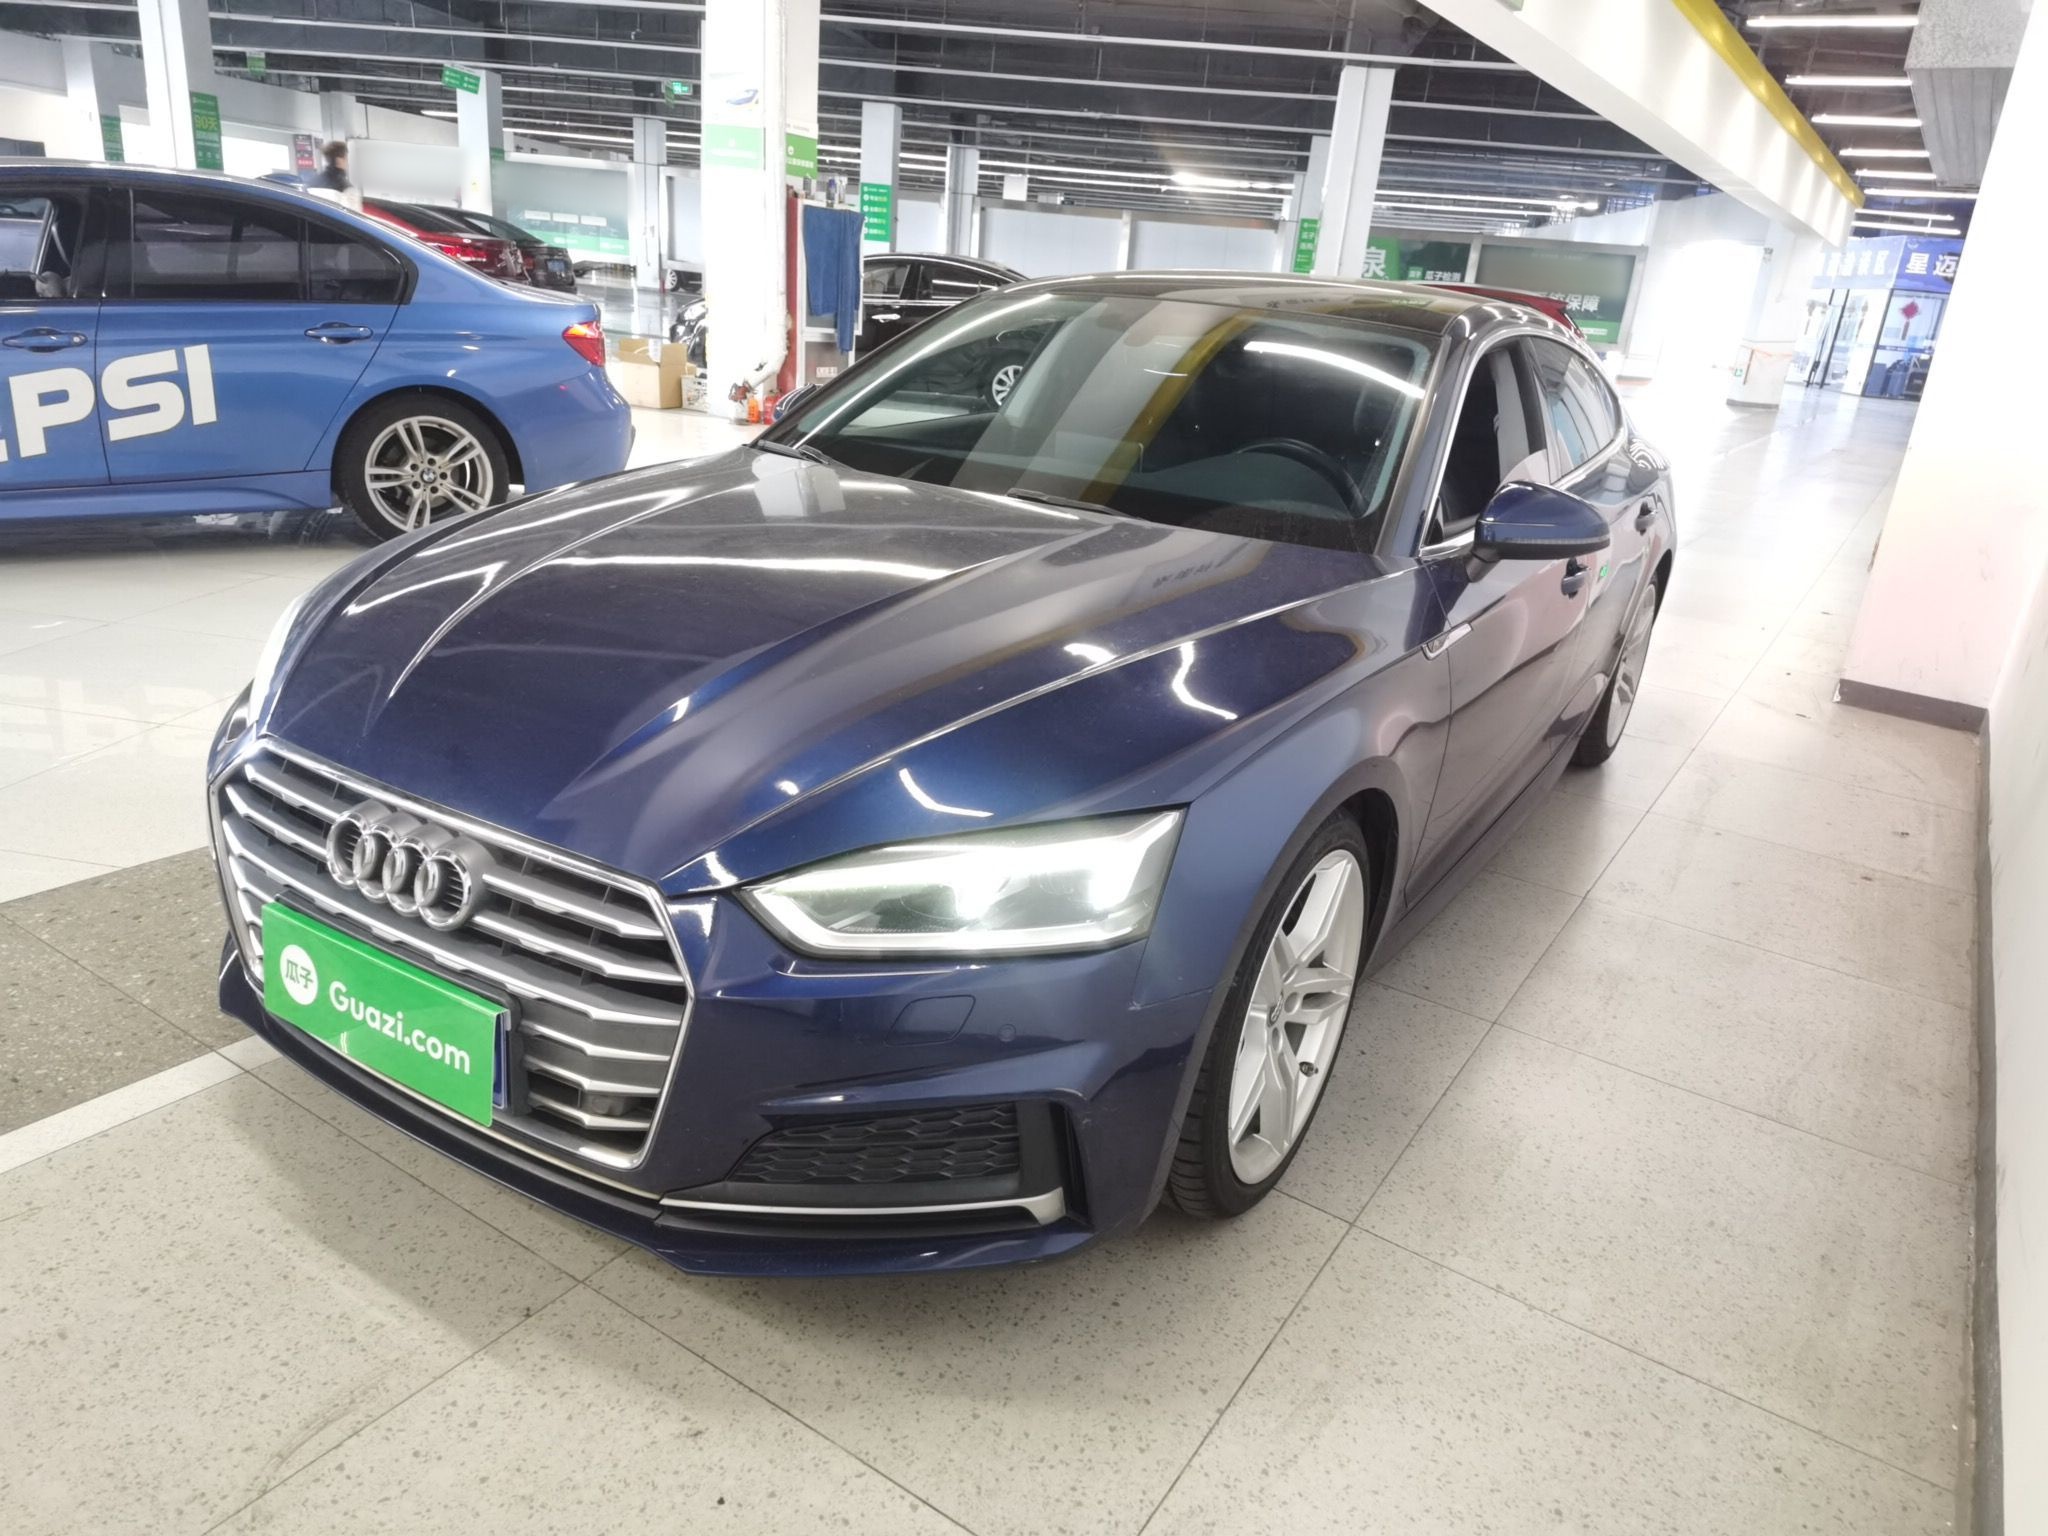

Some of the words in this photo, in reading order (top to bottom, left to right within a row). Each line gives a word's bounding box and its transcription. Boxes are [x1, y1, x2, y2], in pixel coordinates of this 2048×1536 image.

[1905, 252, 1958, 277] 星迈
[1538, 291, 1601, 312] 保障
[0, 344, 217, 462] PSI
[286, 959, 314, 989] 瓜子
[329, 980, 470, 1075] Guazi.com
